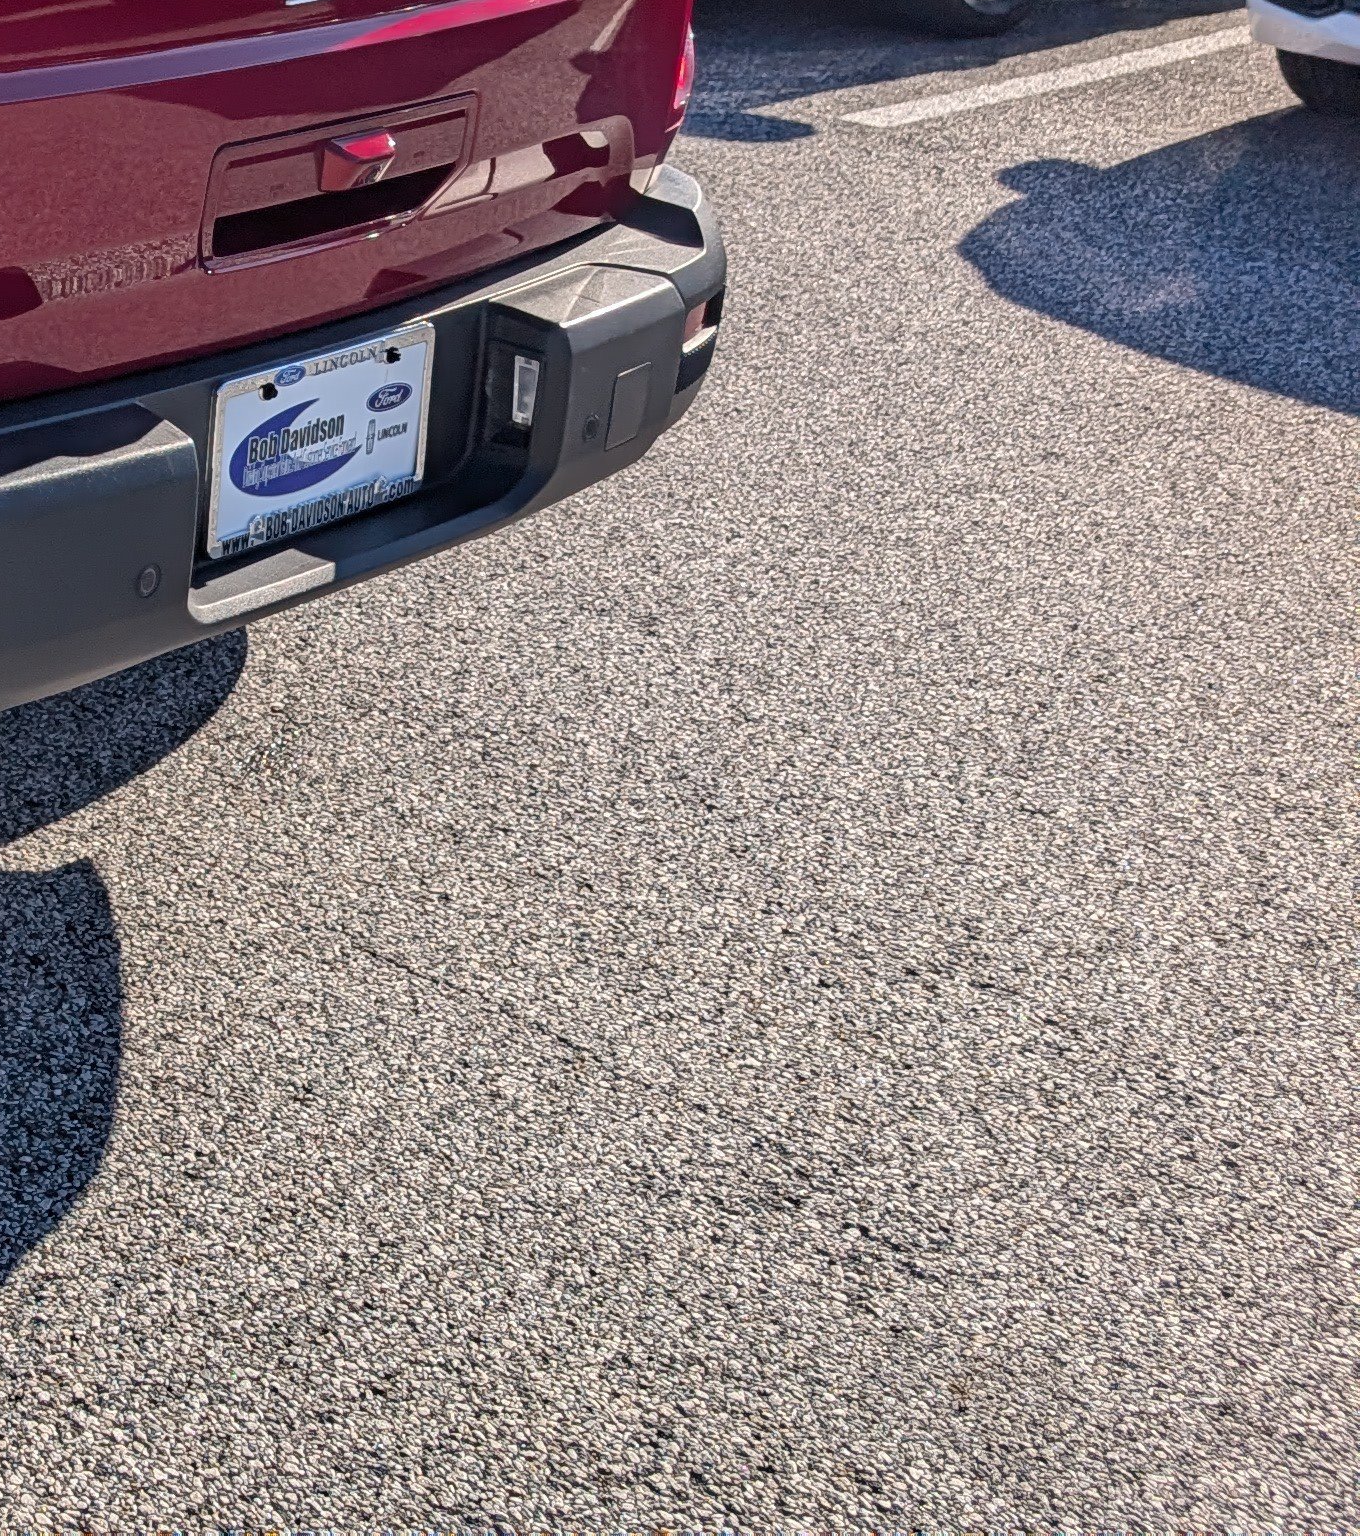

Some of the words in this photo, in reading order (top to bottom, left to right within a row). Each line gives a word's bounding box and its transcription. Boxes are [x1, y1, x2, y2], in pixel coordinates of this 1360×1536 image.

[314, 346, 378, 375] LINCOLN
[248, 430, 278, 463] Bob
[280, 414, 345, 455] Davidson
[377, 421, 408, 441] LINCOLN
